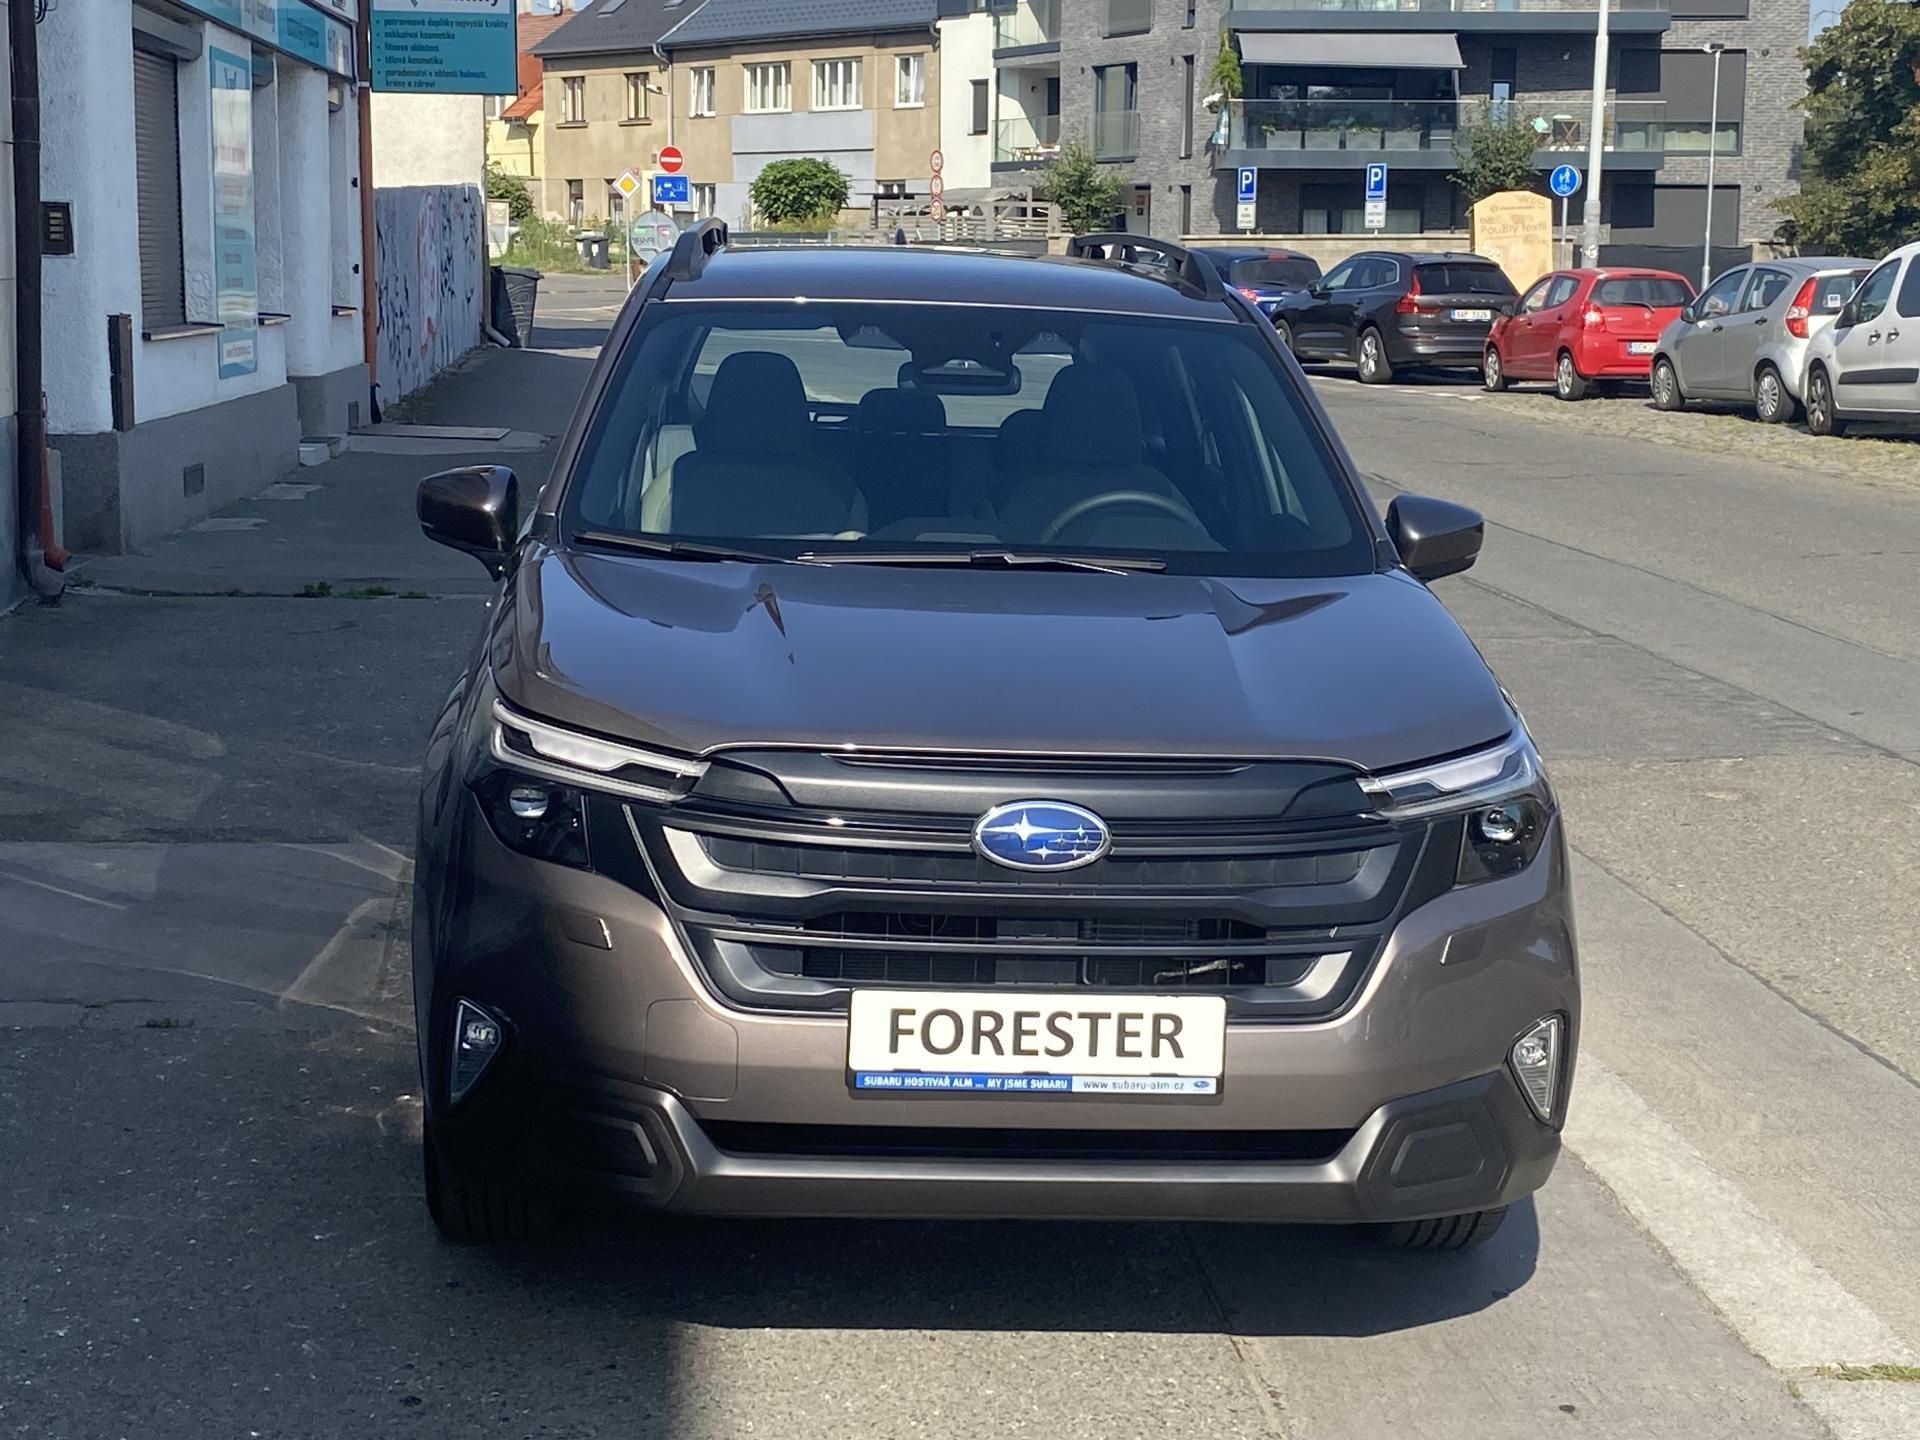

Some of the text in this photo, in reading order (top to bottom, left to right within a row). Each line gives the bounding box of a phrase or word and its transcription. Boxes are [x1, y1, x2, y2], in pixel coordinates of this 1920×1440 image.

[1242, 171, 1253, 192] P
[1370, 168, 1382, 190] P
[889, 1008, 1184, 1058] FORESTER
[864, 1075, 902, 1086] SUBARU
[953, 1078, 973, 1087] ALM
[987, 1079, 1001, 1088] MY
[1004, 1079, 1028, 1089] JSME
[1030, 1079, 1068, 1090] SUBARU
